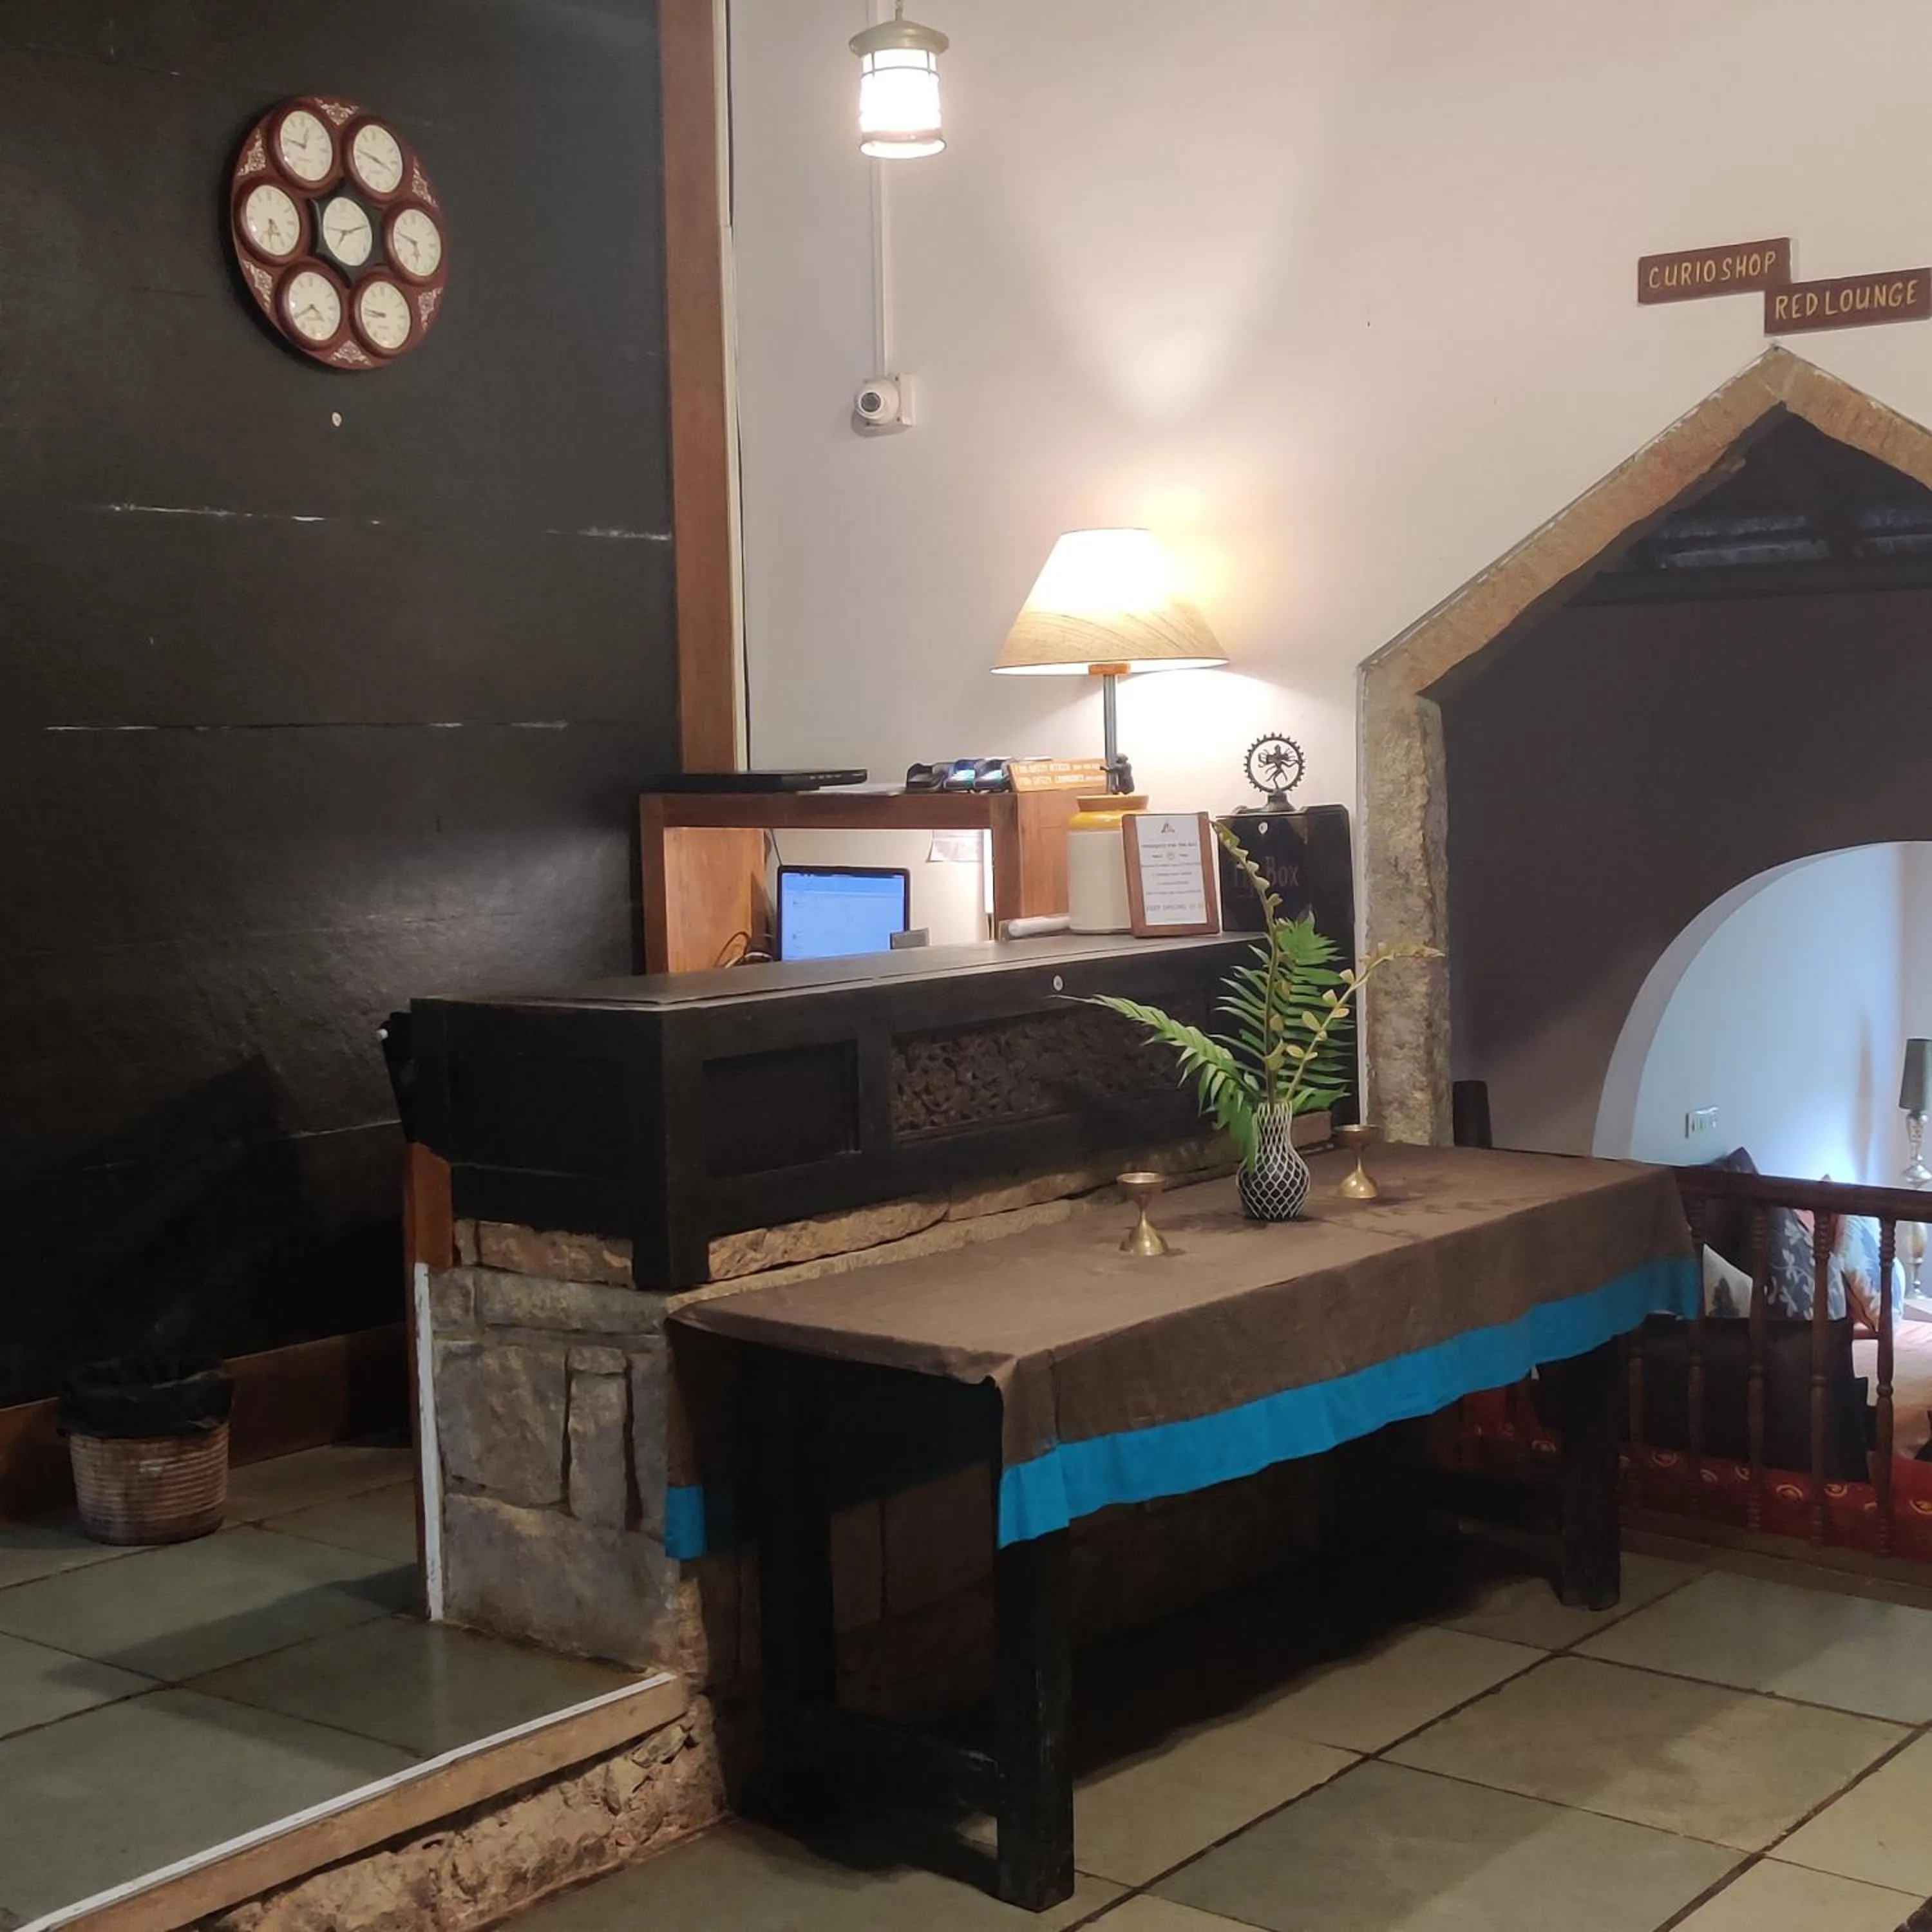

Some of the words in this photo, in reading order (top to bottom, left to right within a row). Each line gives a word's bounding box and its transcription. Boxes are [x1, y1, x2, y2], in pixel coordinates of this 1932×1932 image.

[1649, 259, 1716, 289] CURIO
[1721, 251, 1776, 281] SHOP
[1775, 293, 1819, 320] RED
[1825, 279, 1918, 315] LOUNGE
